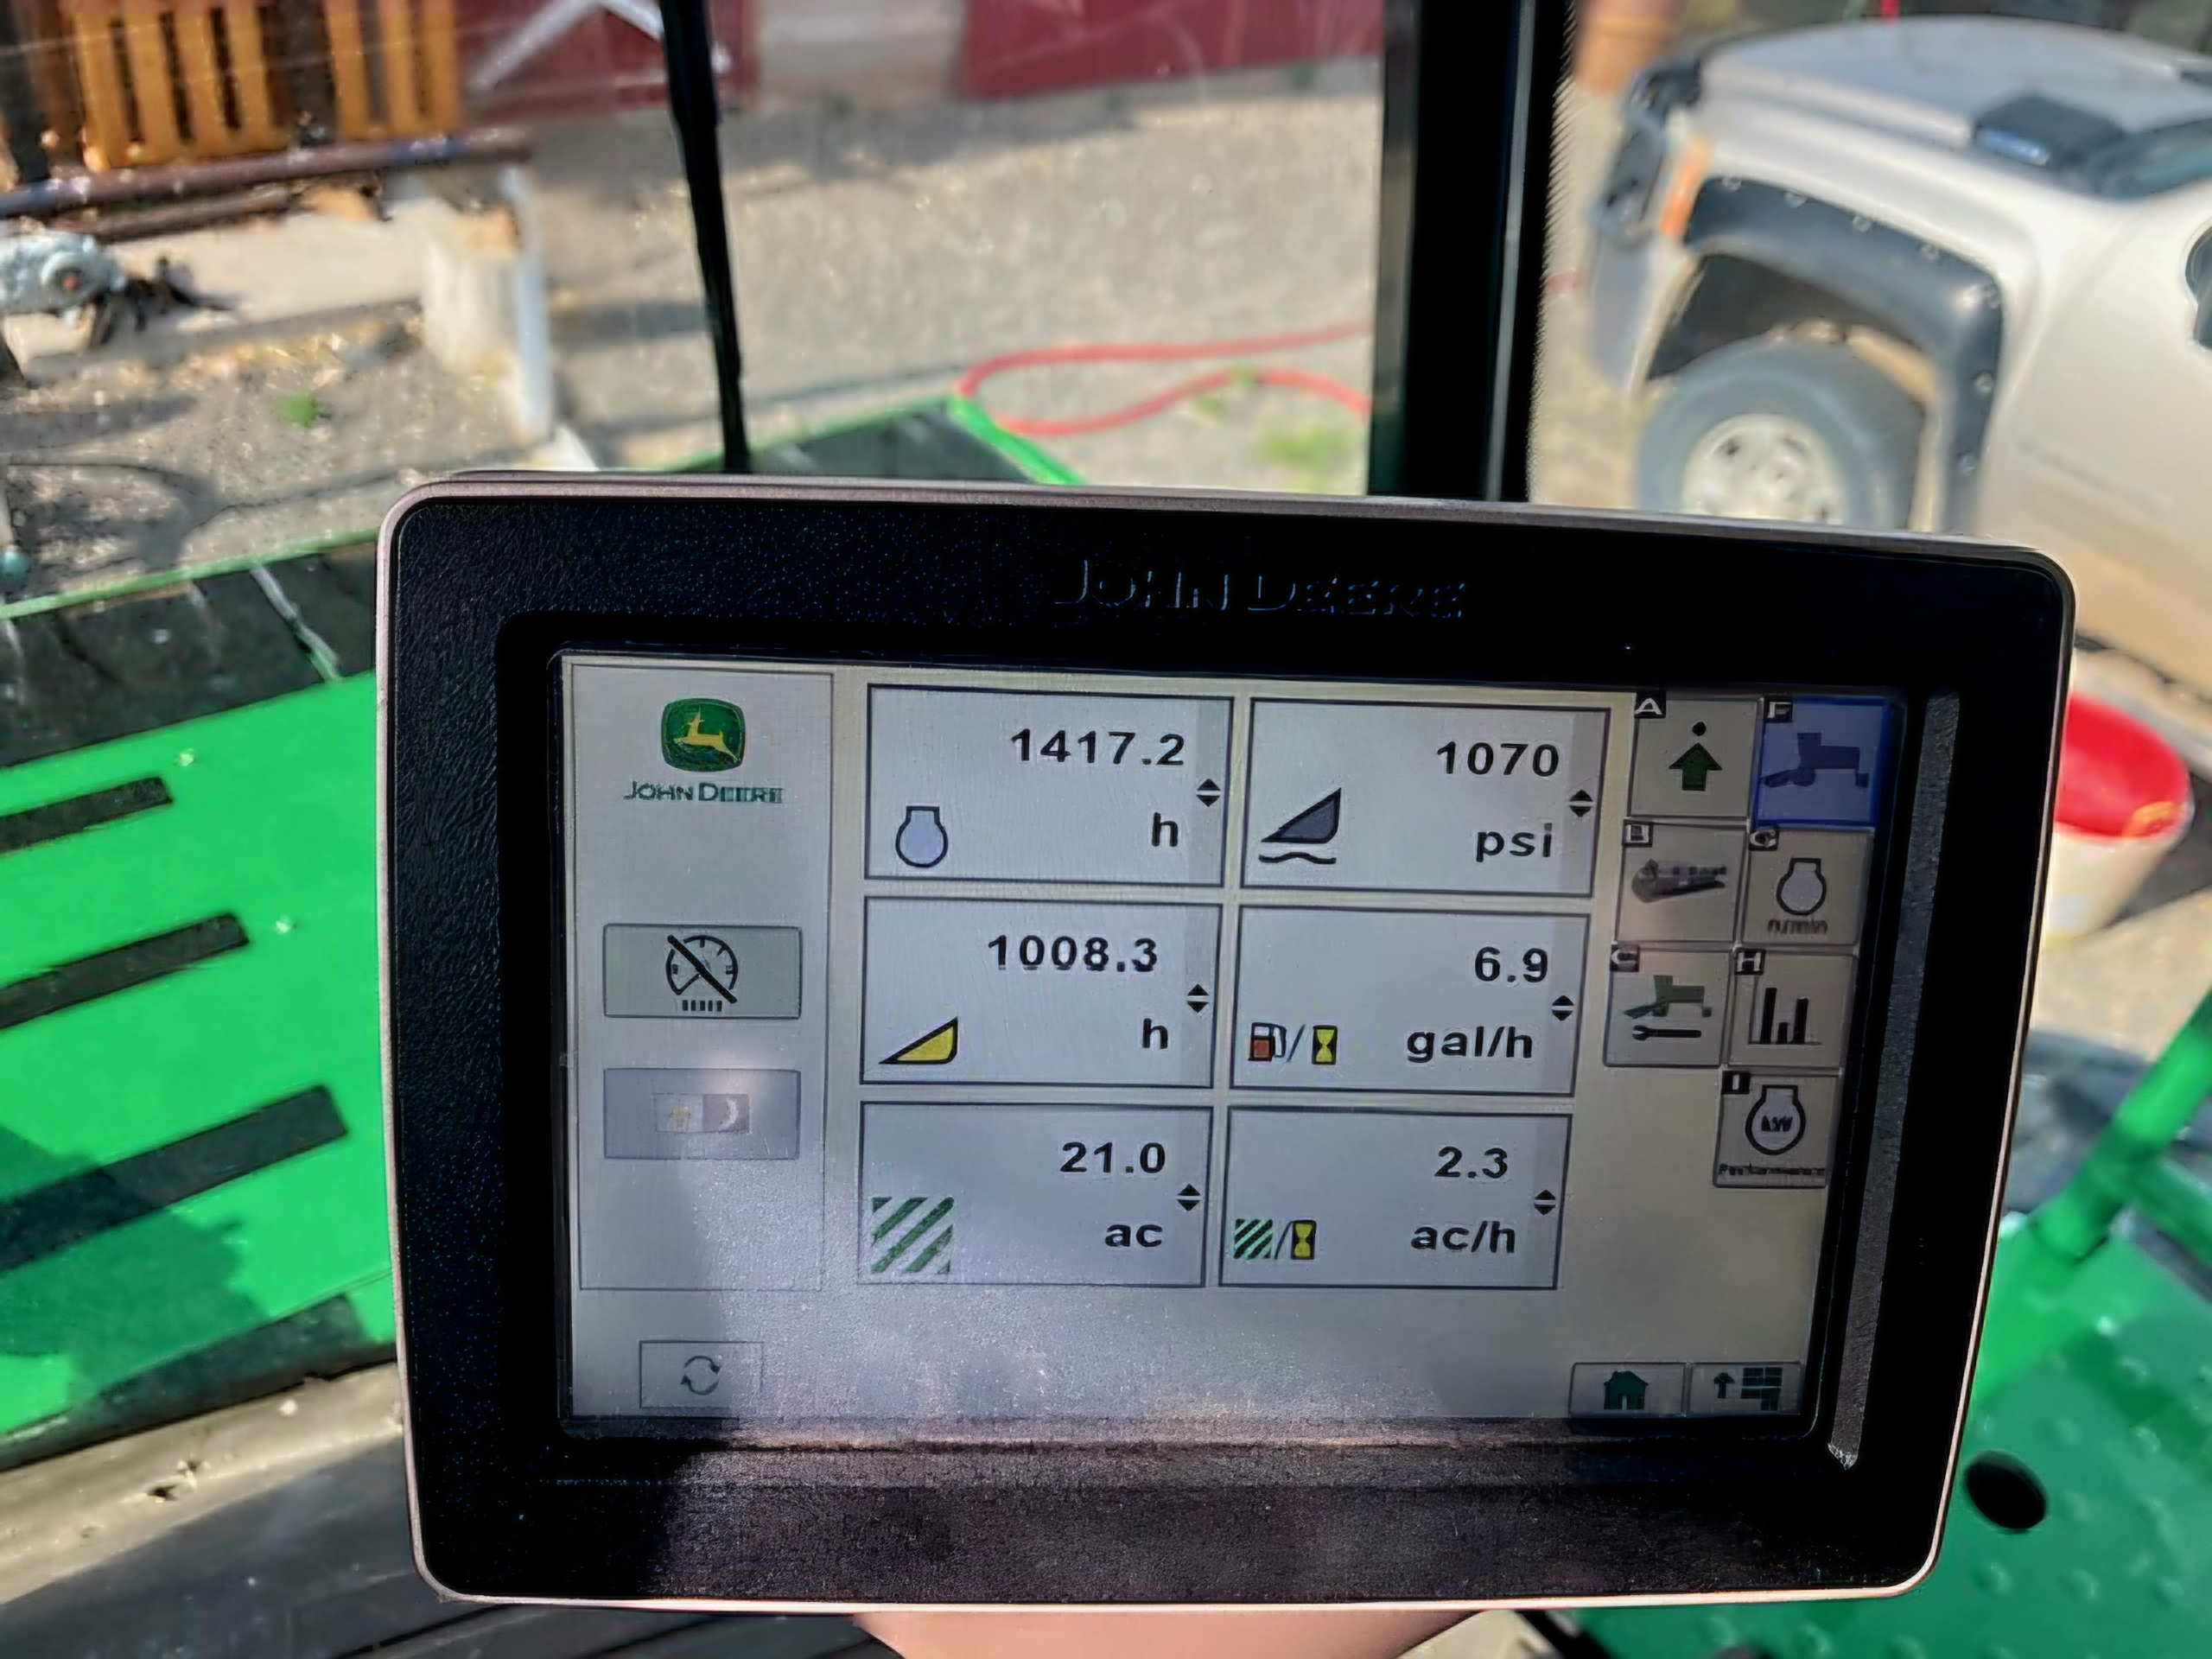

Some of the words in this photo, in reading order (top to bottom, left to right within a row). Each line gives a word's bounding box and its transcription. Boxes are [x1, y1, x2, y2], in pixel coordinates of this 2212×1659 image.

[1011, 728, 1185, 766] 1417.2
[1436, 740, 1560, 777] 1070
[623, 780, 693, 802] JOHN
[1151, 812, 1179, 847] h
[1475, 822, 1553, 862] psi
[988, 934, 1158, 972] 1008.3
[1474, 946, 1549, 983] 6.9
[1141, 1018, 1169, 1049] h
[1407, 1026, 1533, 1063] gal/h
[1059, 1141, 1166, 1173] 21.0
[1433, 1146, 1509, 1179] 2.3
[1104, 1224, 1163, 1248] ac
[1410, 1220, 1516, 1254] ac/h
